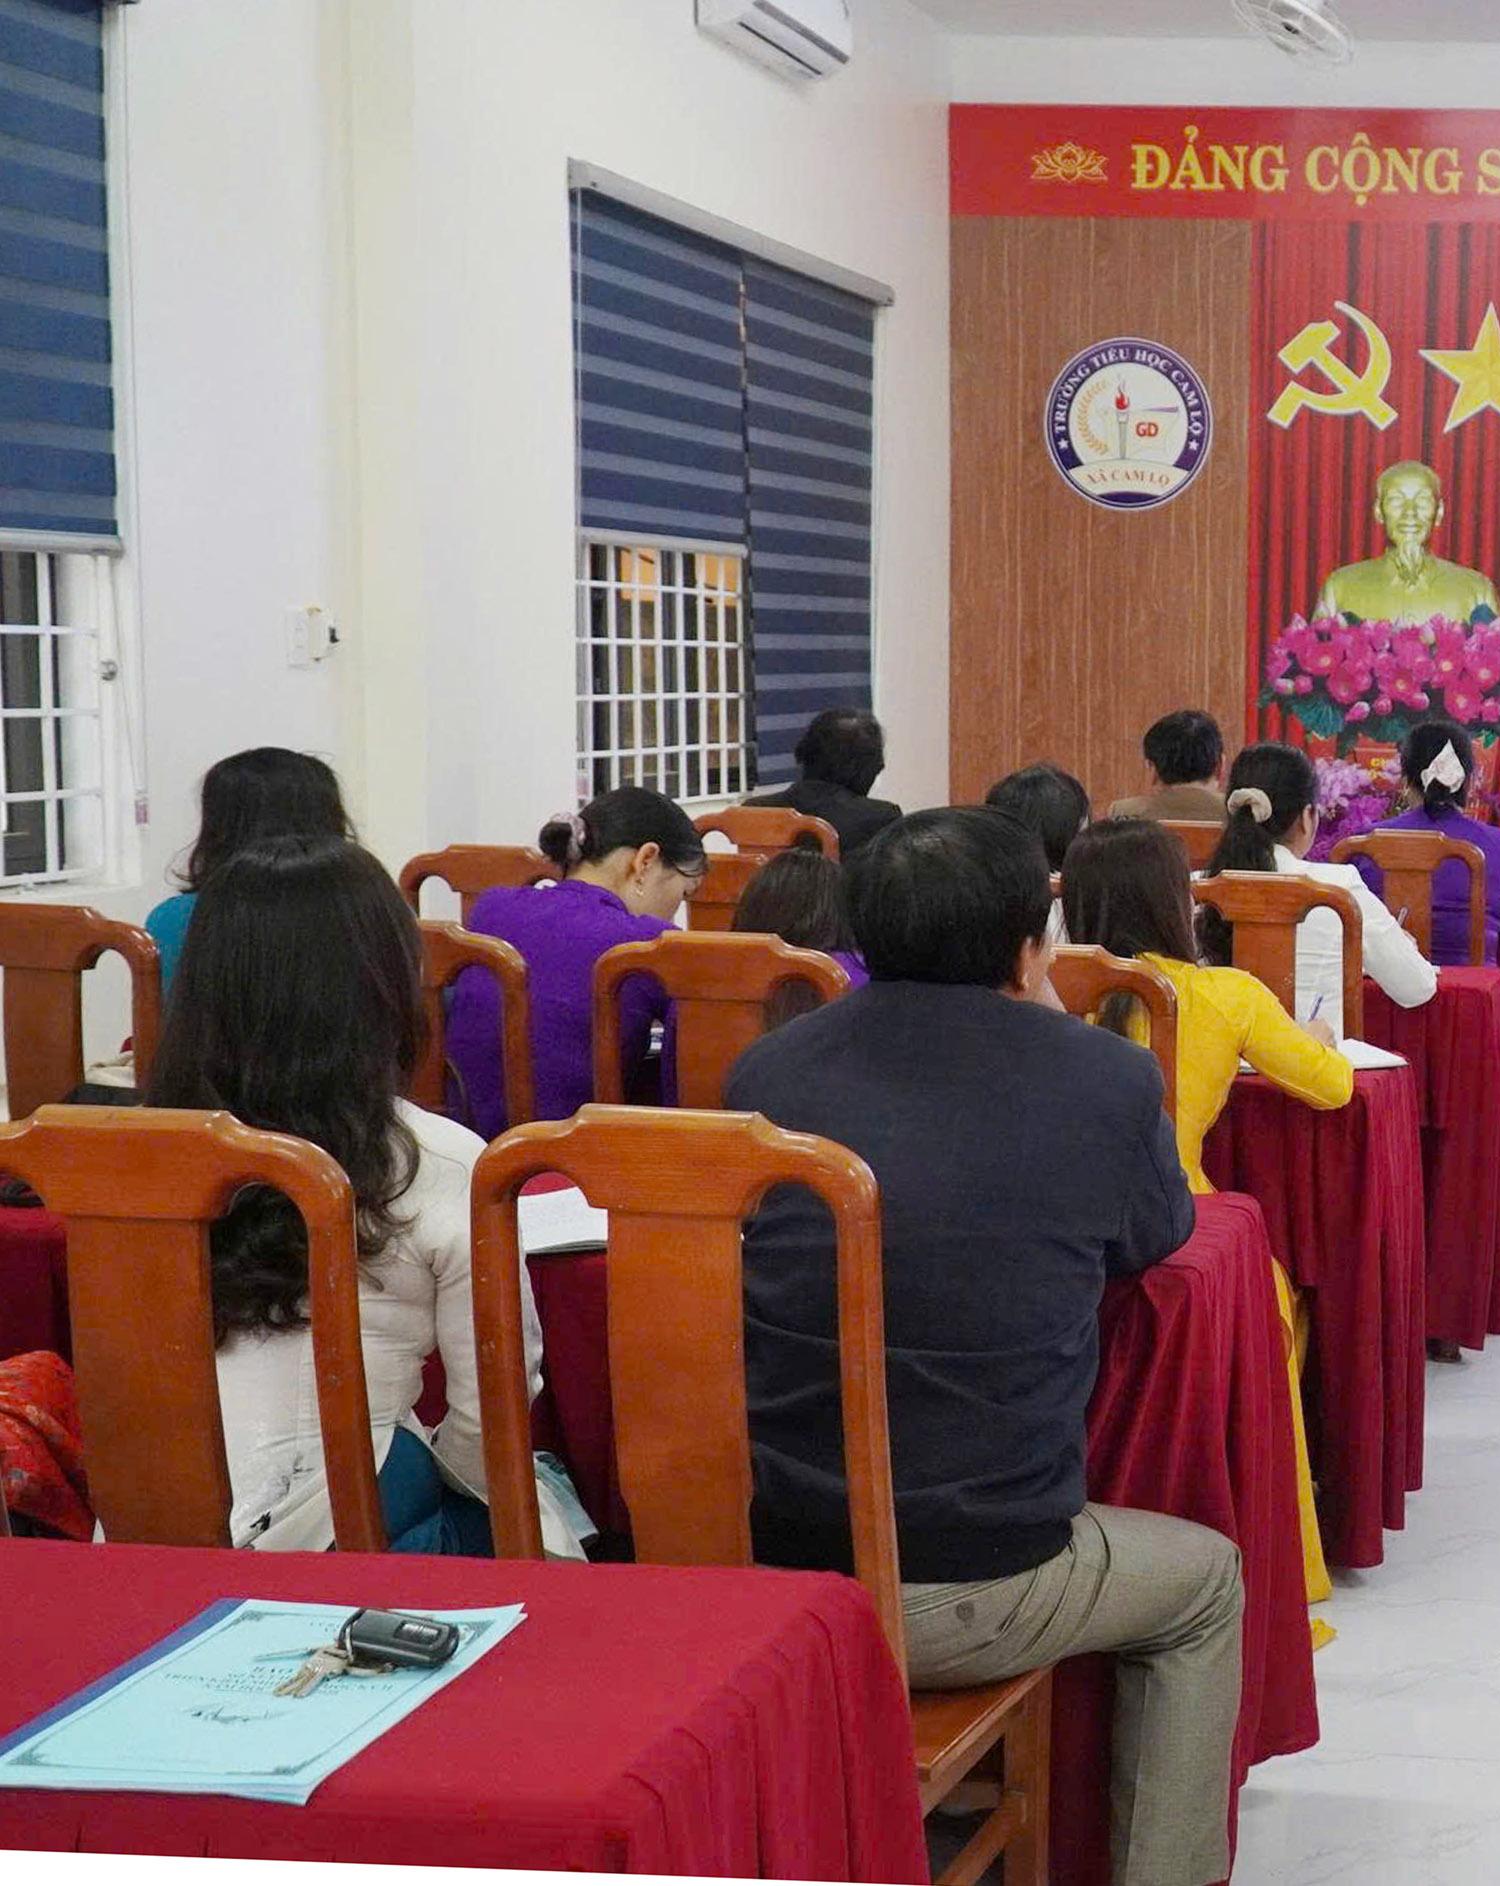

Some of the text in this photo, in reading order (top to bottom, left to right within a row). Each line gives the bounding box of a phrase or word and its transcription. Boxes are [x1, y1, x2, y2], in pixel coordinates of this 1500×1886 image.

[1131, 125, 1290, 191] ĐẢNG
[1305, 132, 1462, 206] CỘNG
[1134, 348, 1174, 373] HỌC
